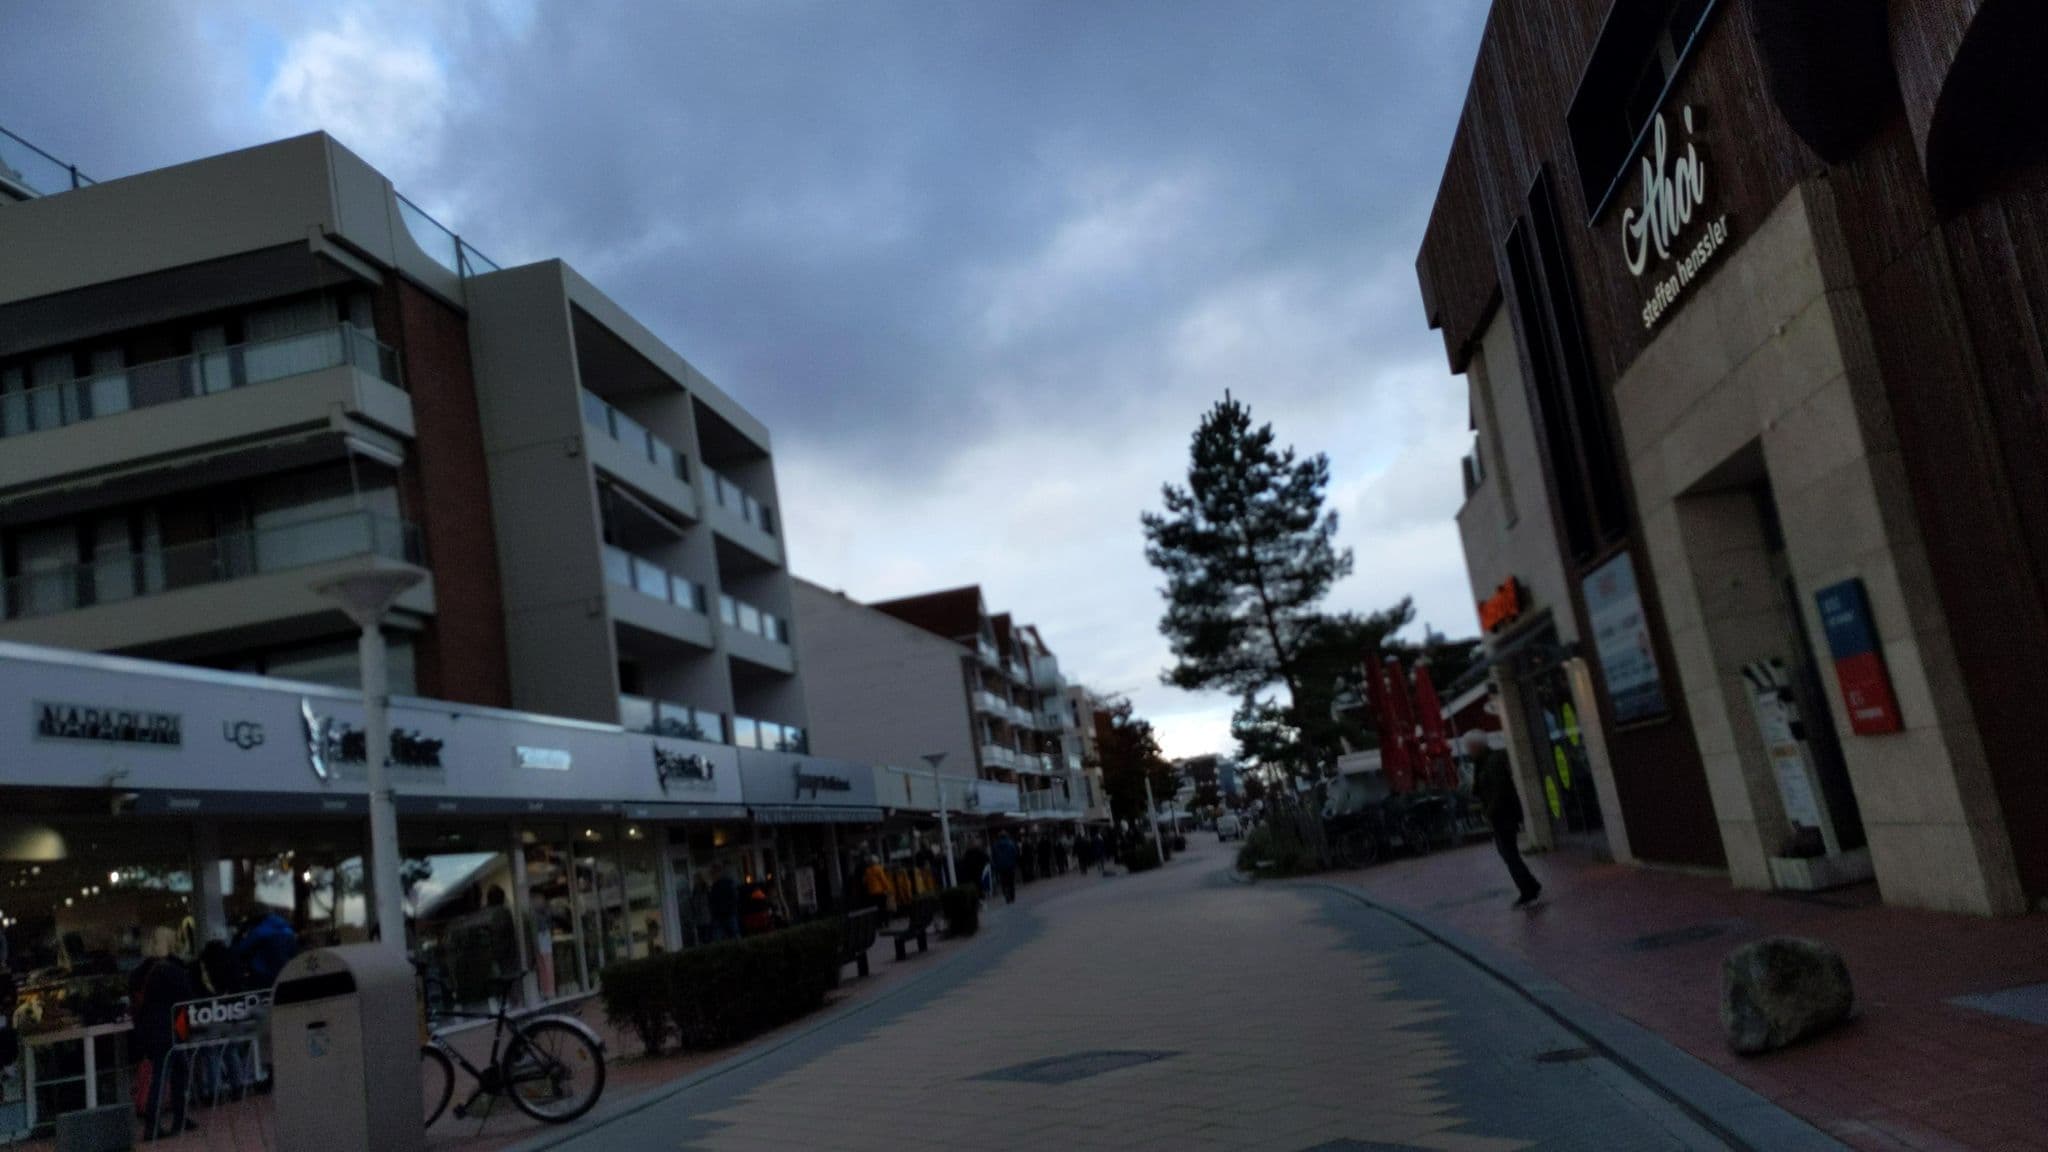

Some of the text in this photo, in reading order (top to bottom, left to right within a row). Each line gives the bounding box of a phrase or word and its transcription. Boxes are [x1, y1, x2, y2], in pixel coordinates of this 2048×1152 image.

[1622, 105, 1704, 276] Ahoi
[1642, 213, 1729, 329] steffen henssler
[222, 719, 264, 749] UGG
